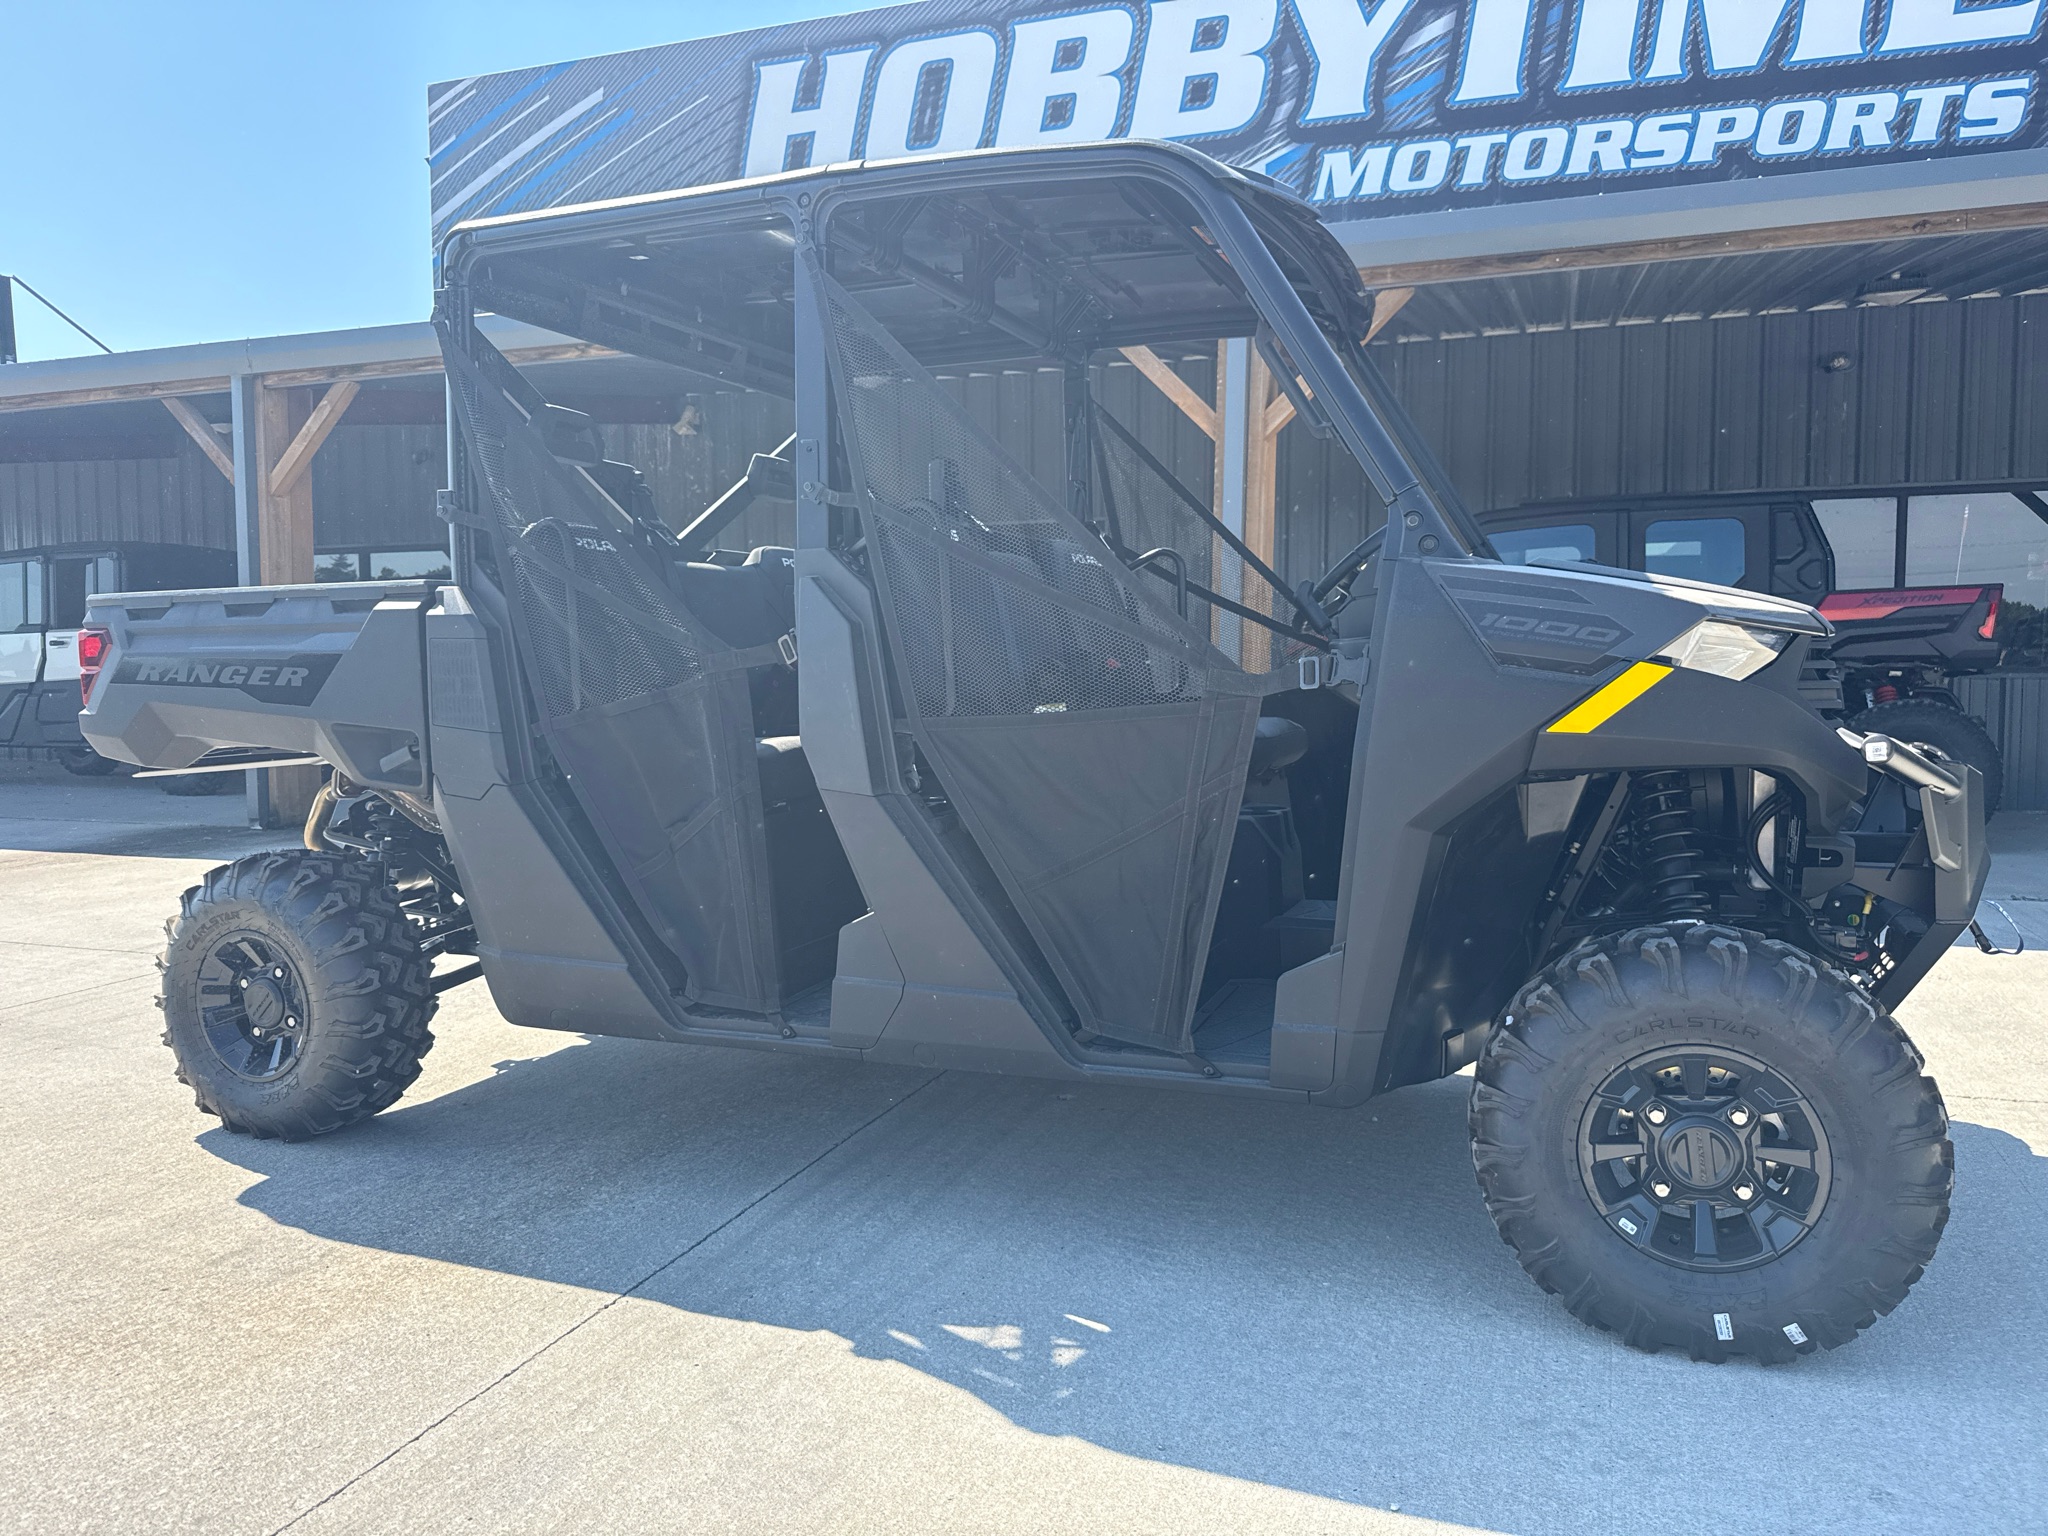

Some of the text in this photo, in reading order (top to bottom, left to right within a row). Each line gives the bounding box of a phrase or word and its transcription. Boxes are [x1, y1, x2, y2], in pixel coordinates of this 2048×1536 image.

[1313, 77, 2032, 202] MOTORSPORTS
[1479, 612, 1621, 643] 1000
[135, 660, 310, 687] RANGER
[186, 910, 241, 951] CARLSTAR
[1614, 1016, 1761, 1044] CARLSTAR
